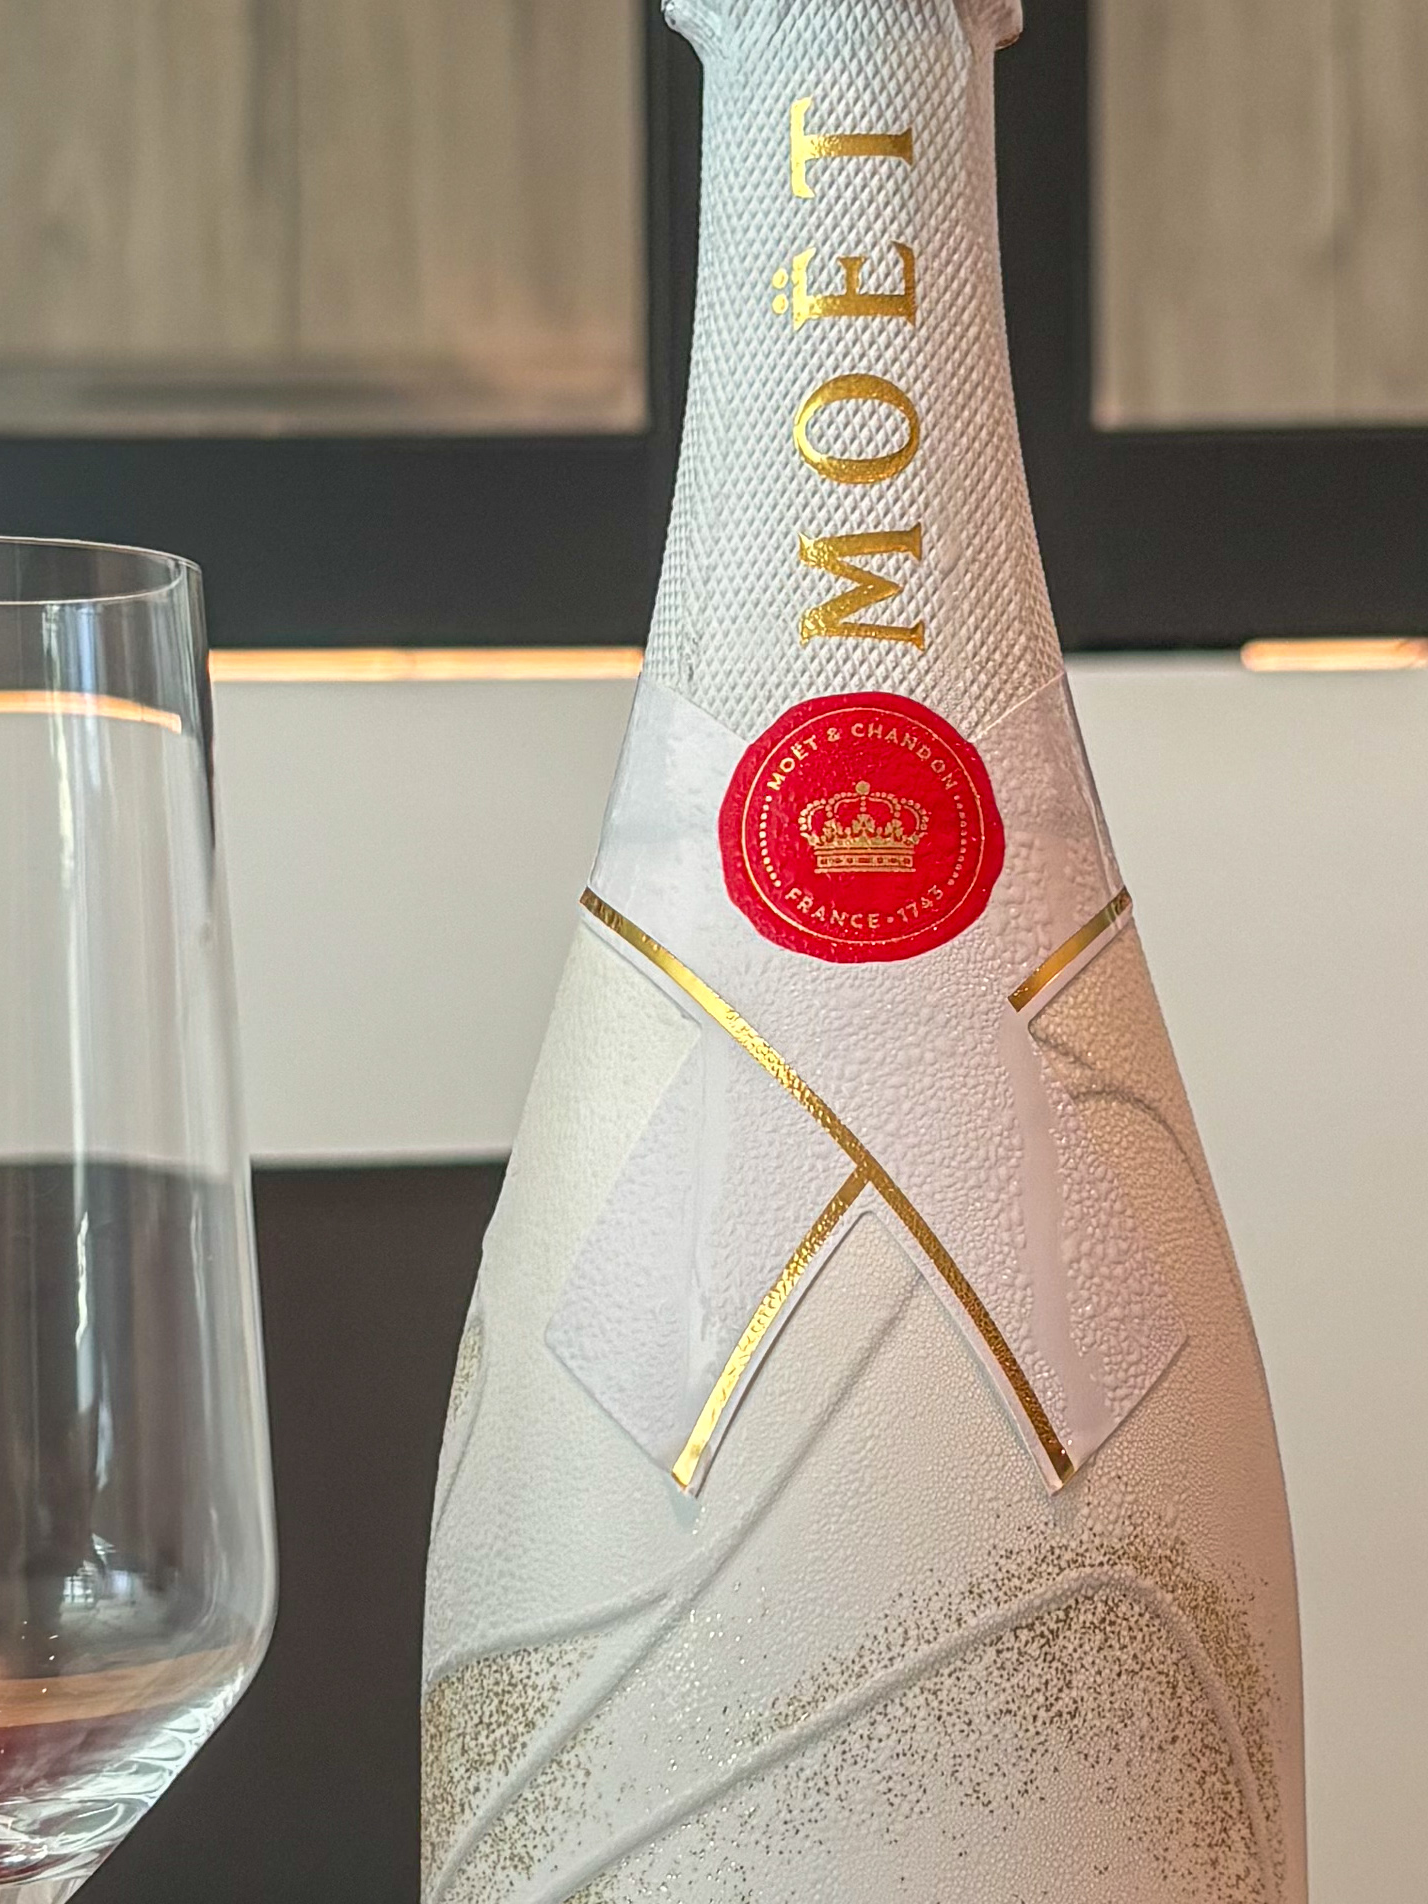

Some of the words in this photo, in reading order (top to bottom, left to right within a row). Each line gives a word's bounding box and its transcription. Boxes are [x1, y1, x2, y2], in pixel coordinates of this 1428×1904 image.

[771, 95, 926, 652] MOËT
[825, 727, 841, 743] &
[850, 722, 957, 790] CHANDON
[785, 887, 879, 928] FRANCE
